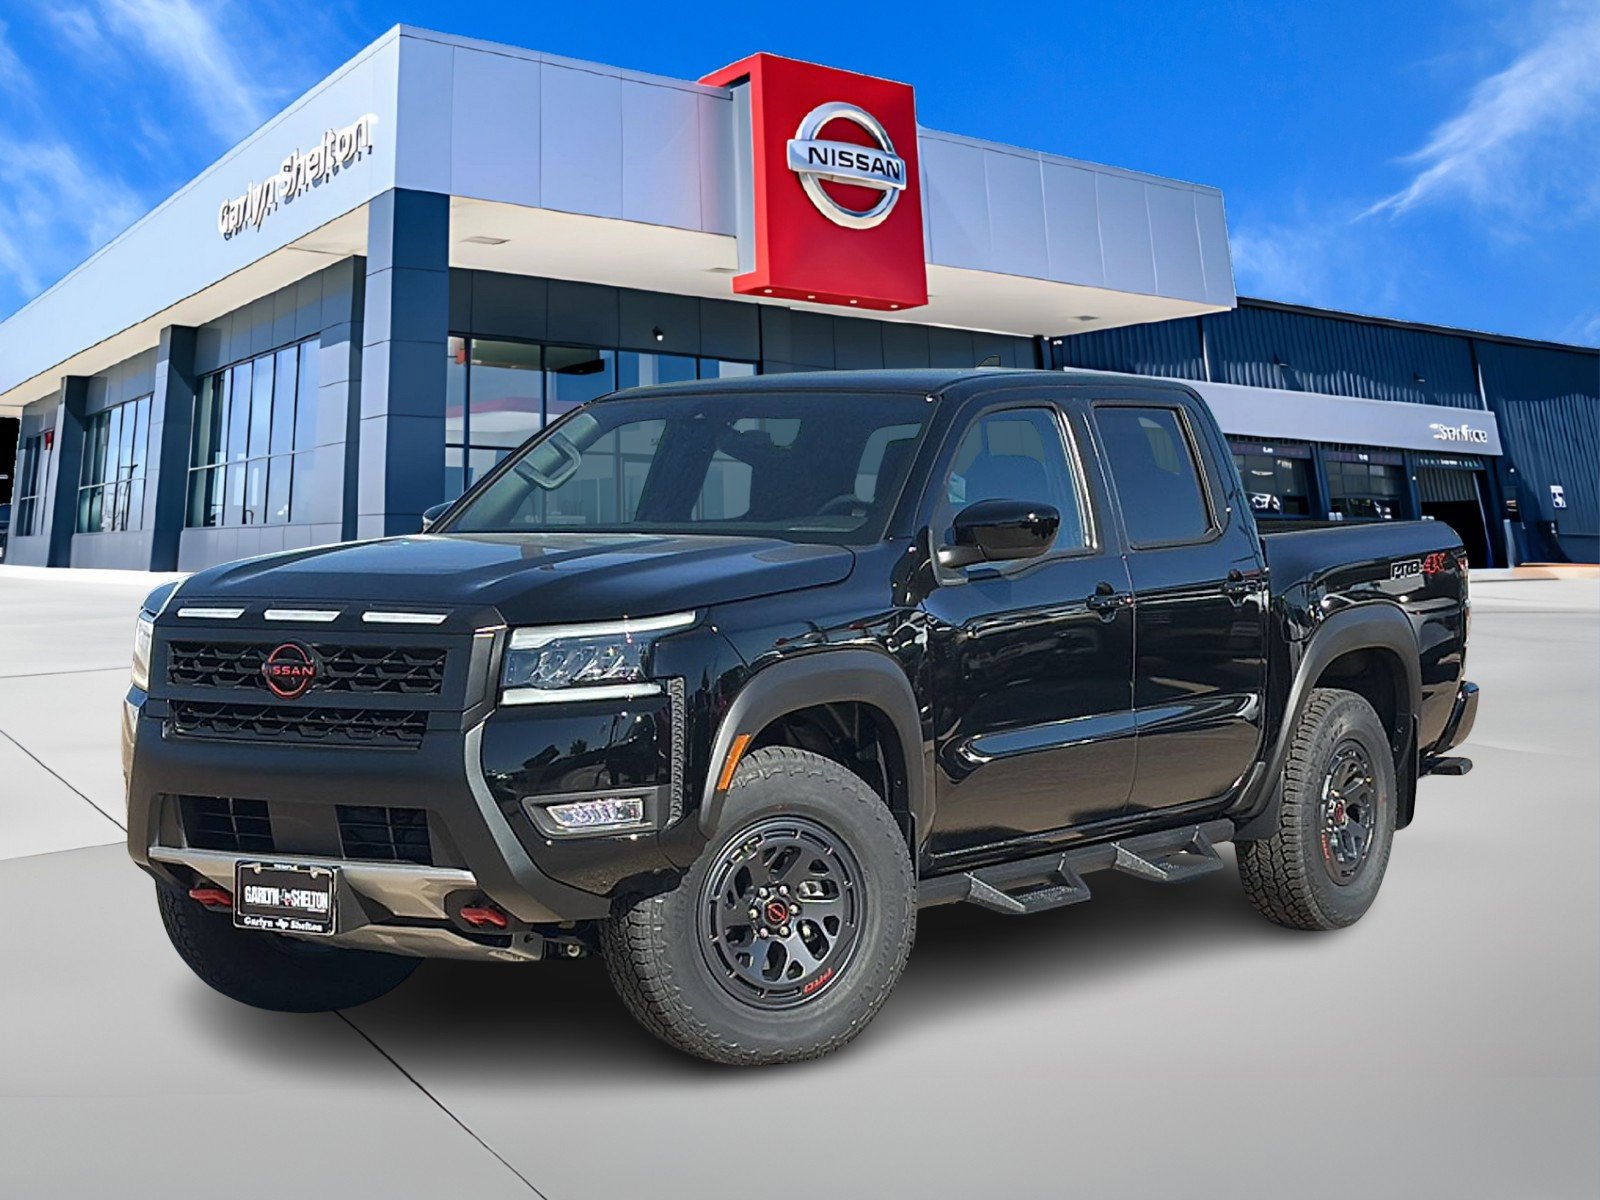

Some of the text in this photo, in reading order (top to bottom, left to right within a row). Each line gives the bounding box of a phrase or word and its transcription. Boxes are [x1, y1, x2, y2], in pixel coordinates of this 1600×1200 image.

[279, 114, 374, 202] Shelton
[808, 147, 900, 180] NISSAN
[291, 889, 328, 908] SHELTON
